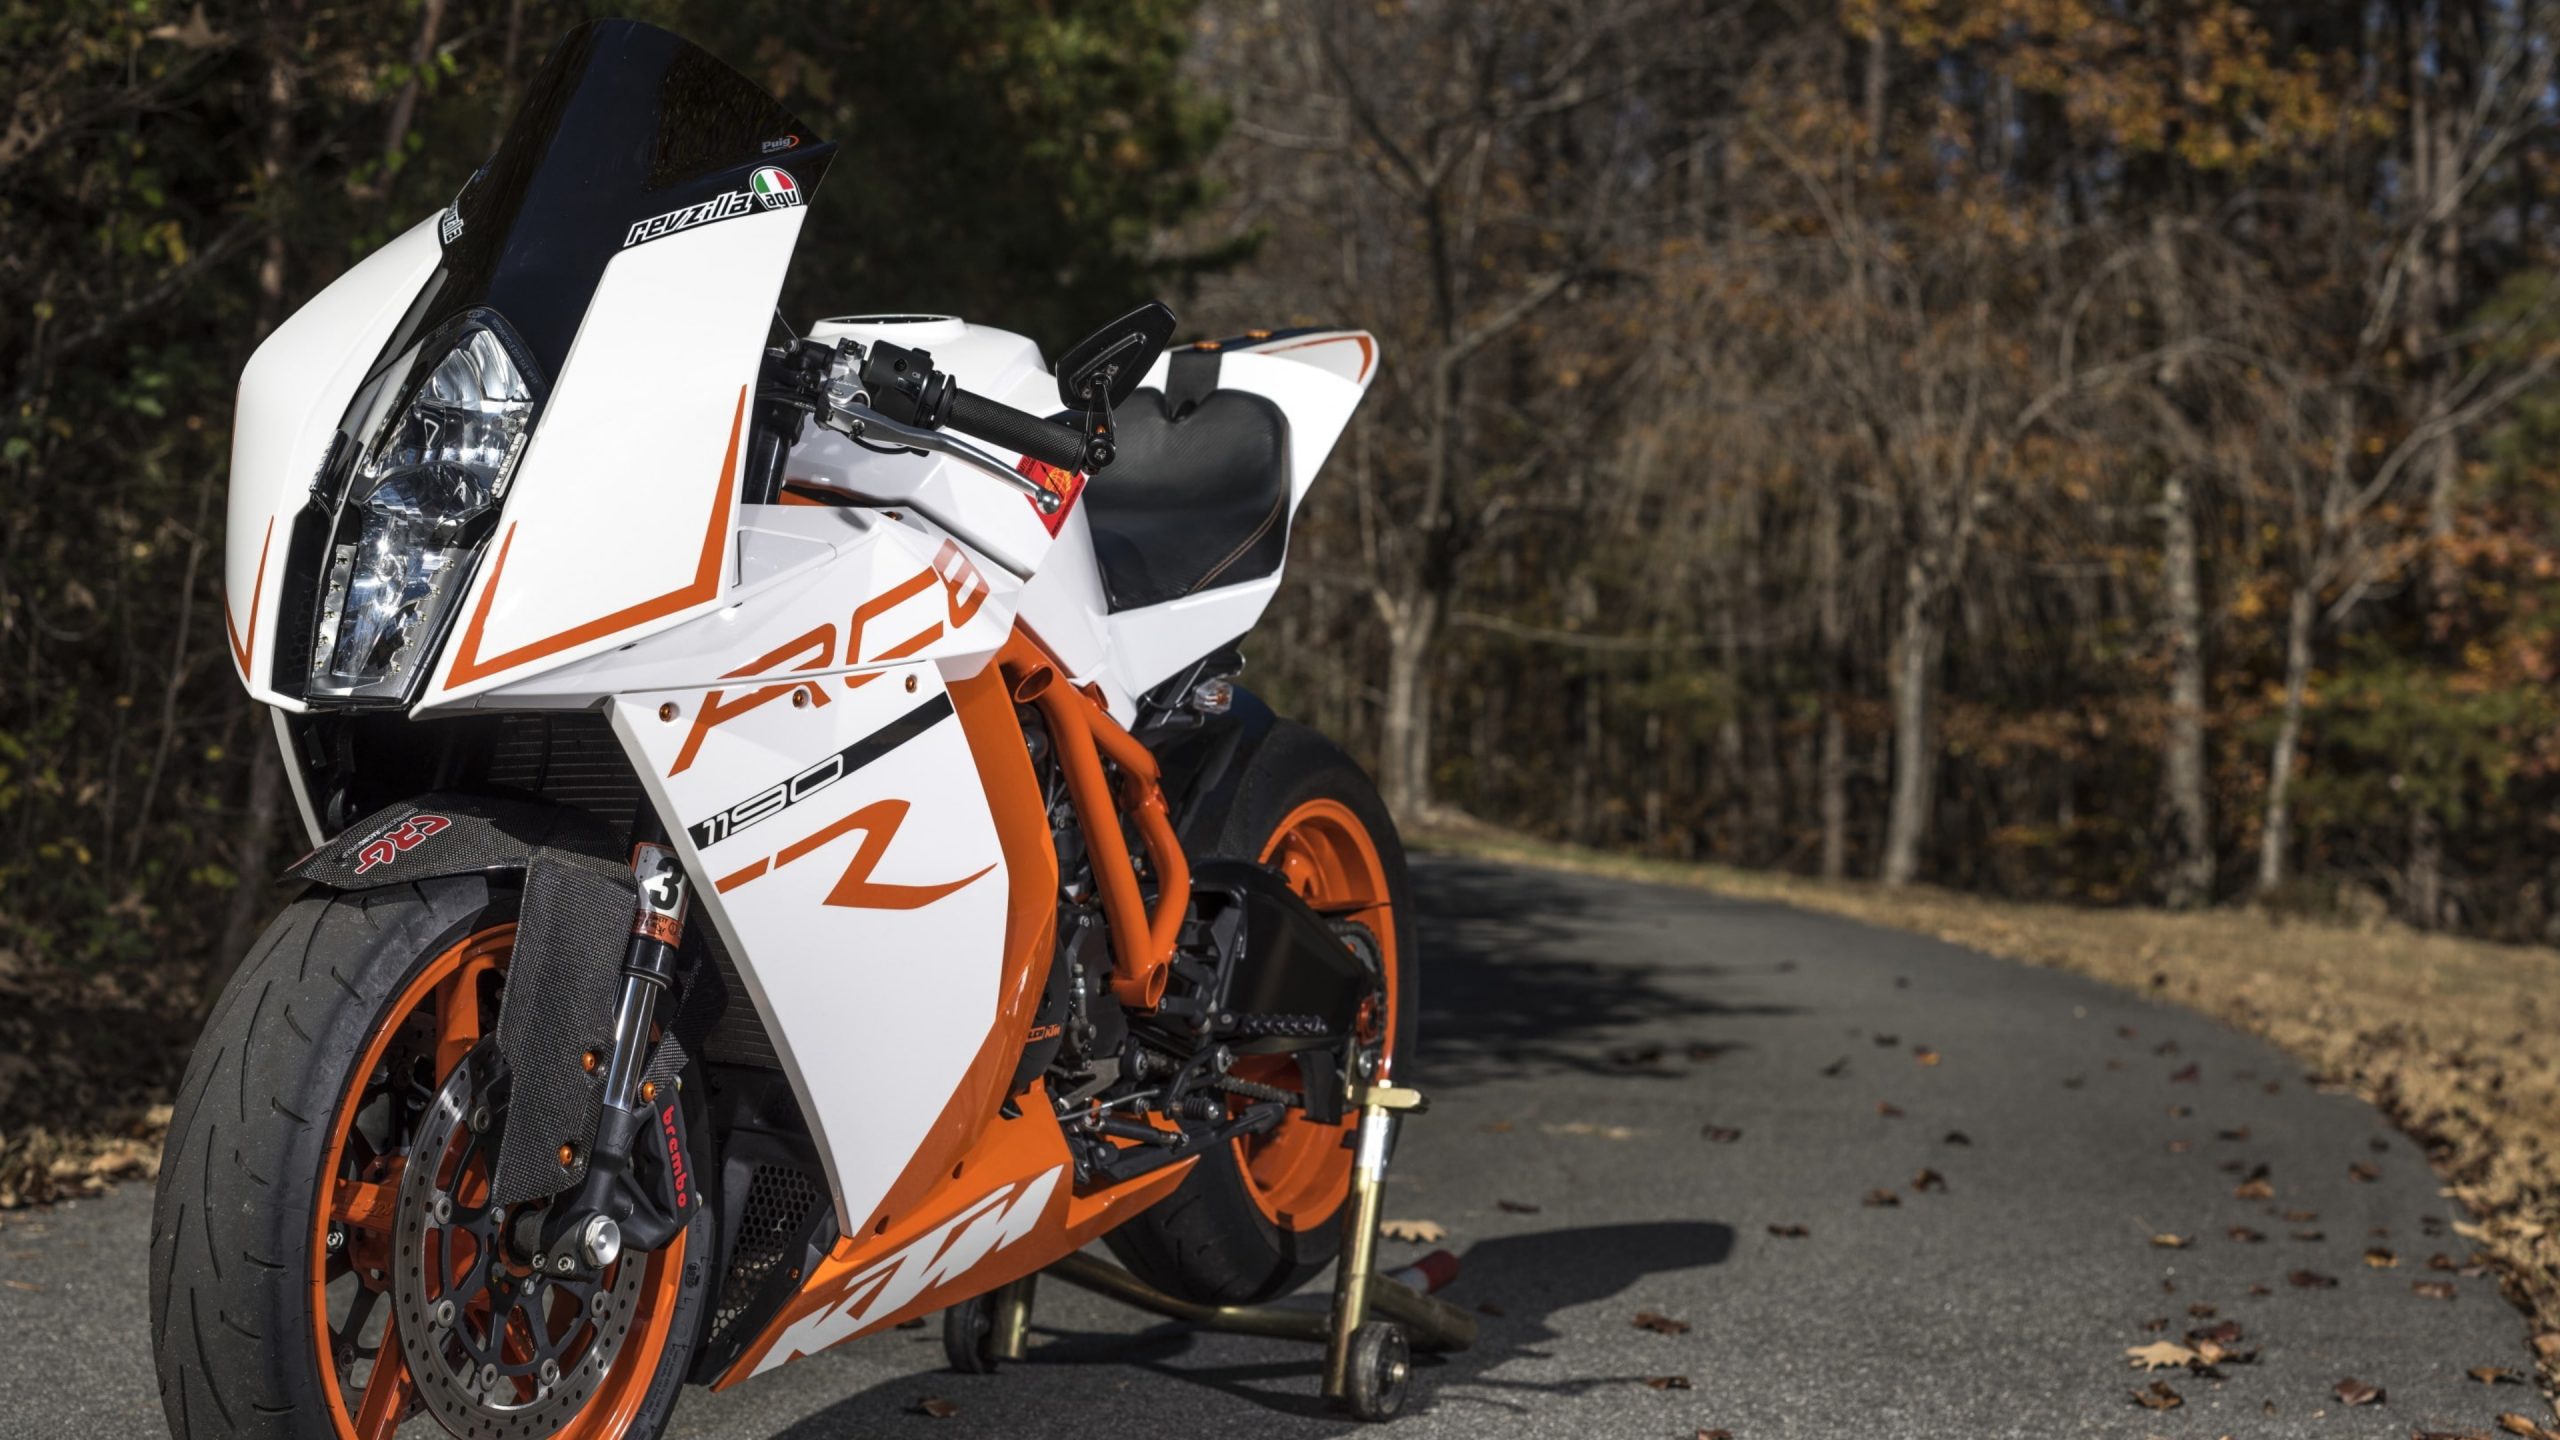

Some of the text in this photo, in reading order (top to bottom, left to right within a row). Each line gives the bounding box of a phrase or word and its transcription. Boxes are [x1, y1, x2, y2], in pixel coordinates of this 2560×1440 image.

[762, 137, 792, 150] Puig
[625, 191, 752, 247] revzilla
[765, 190, 798, 207] agv
[702, 753, 844, 845] 1190
[355, 815, 451, 874] CRG
[649, 857, 683, 910] 3
[662, 1104, 688, 1208] brembo
[748, 1164, 1065, 1379] KTM
